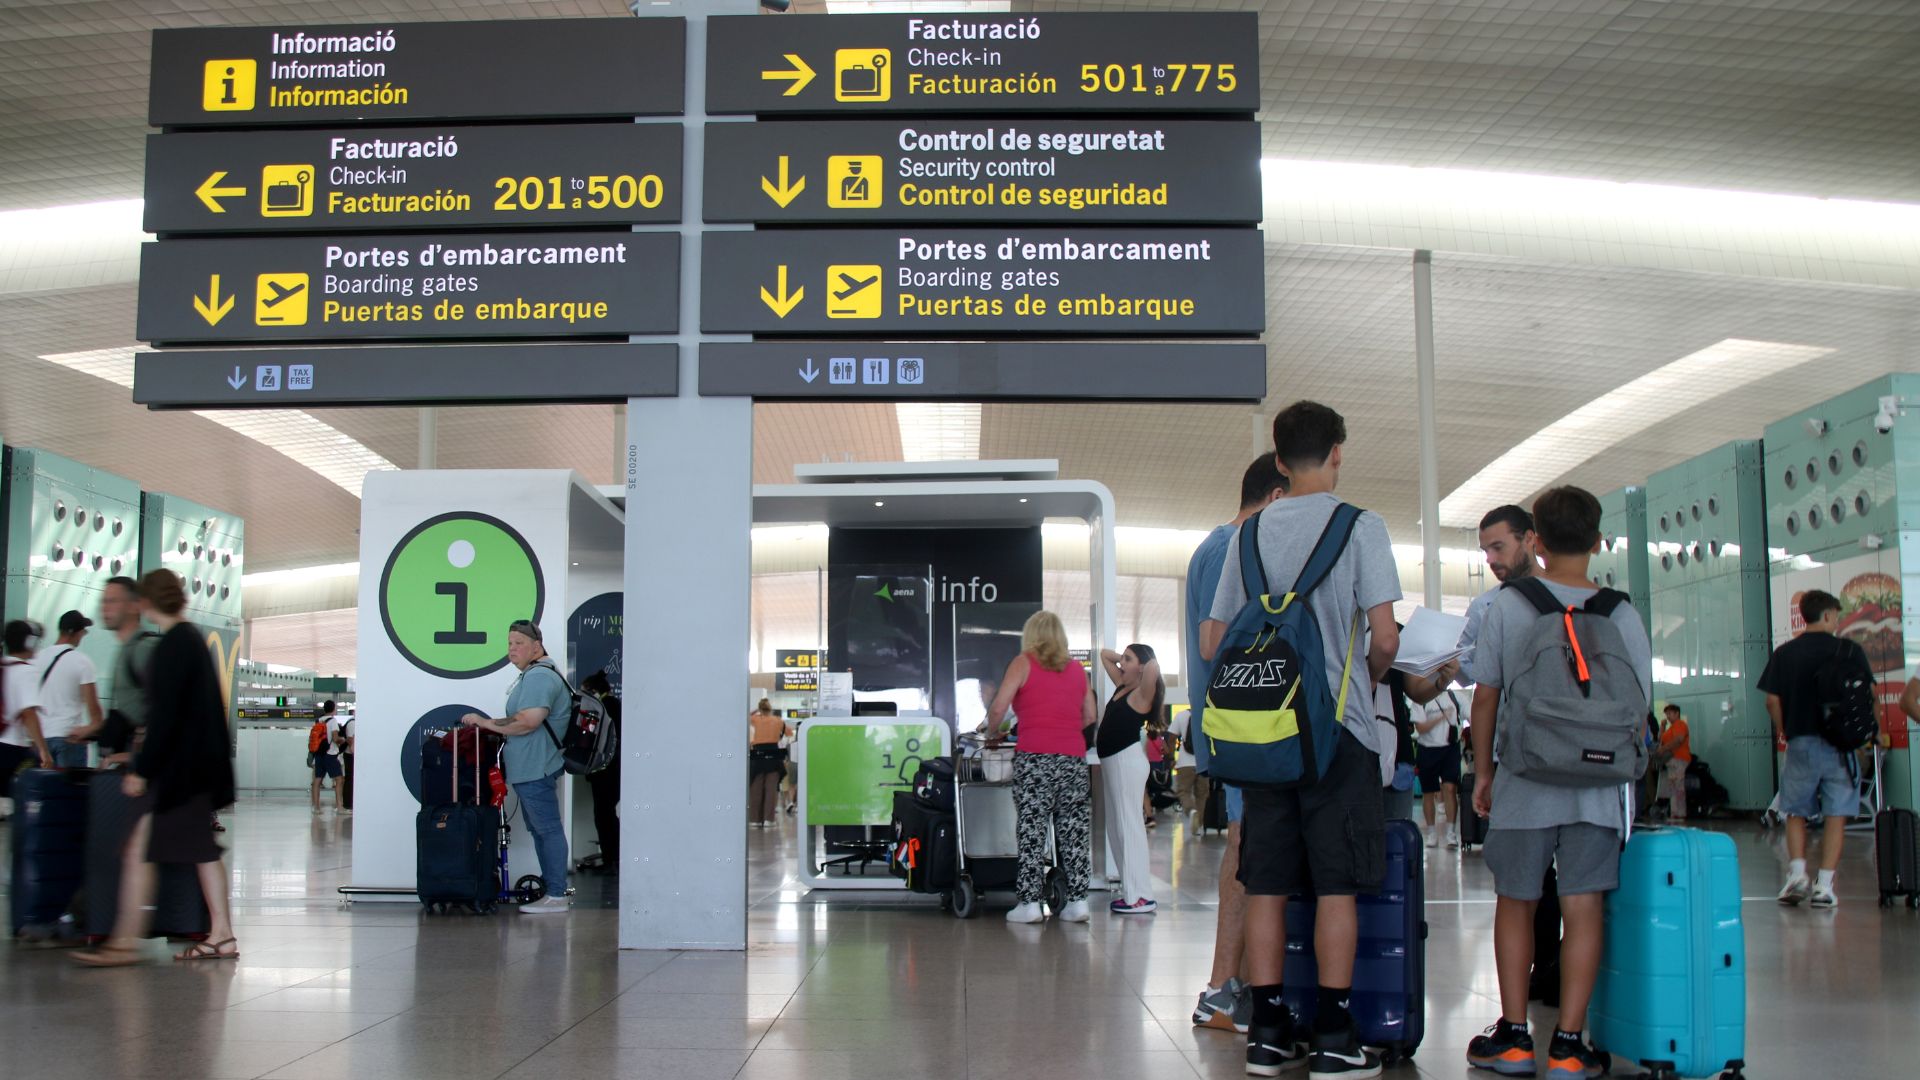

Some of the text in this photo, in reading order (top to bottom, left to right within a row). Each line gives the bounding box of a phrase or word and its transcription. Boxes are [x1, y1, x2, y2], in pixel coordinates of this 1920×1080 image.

[909, 18, 1040, 40] Facturació
[273, 30, 396, 55] Informació
[271, 59, 385, 78] Information
[908, 48, 1001, 67] Check-in
[909, 72, 1056, 95] Facturación
[1081, 64, 1237, 92] 501 to 775
[270, 83, 407, 107] Información
[1155, 85, 1164, 95] a
[331, 136, 457, 160] Facturació
[899, 129, 1164, 154] Control de seguretat
[330, 165, 406, 185] Check-in
[899, 158, 1055, 180] Security control
[329, 190, 470, 214] Facturación
[494, 175, 663, 210] 201 to 500
[572, 198, 581, 208] a
[899, 184, 1167, 209] Control de seguridad
[326, 247, 409, 268] Portes
[899, 238, 986, 260] Portes
[324, 274, 478, 296] Boarding gates
[899, 267, 1060, 290] Boarding gates
[324, 298, 608, 324] Puertas de embarque
[899, 294, 1195, 320] Puertas de embarque
[290, 377, 311, 385] FREE
[293, 369, 309, 377] TAX
[628, 444, 637, 490] SE 00200
[893, 588, 914, 597] aena
[942, 576, 998, 603] info
[583, 615, 601, 629] vip
[1791, 616, 1807, 631] KIN
[1213, 659, 1287, 689] VANS
